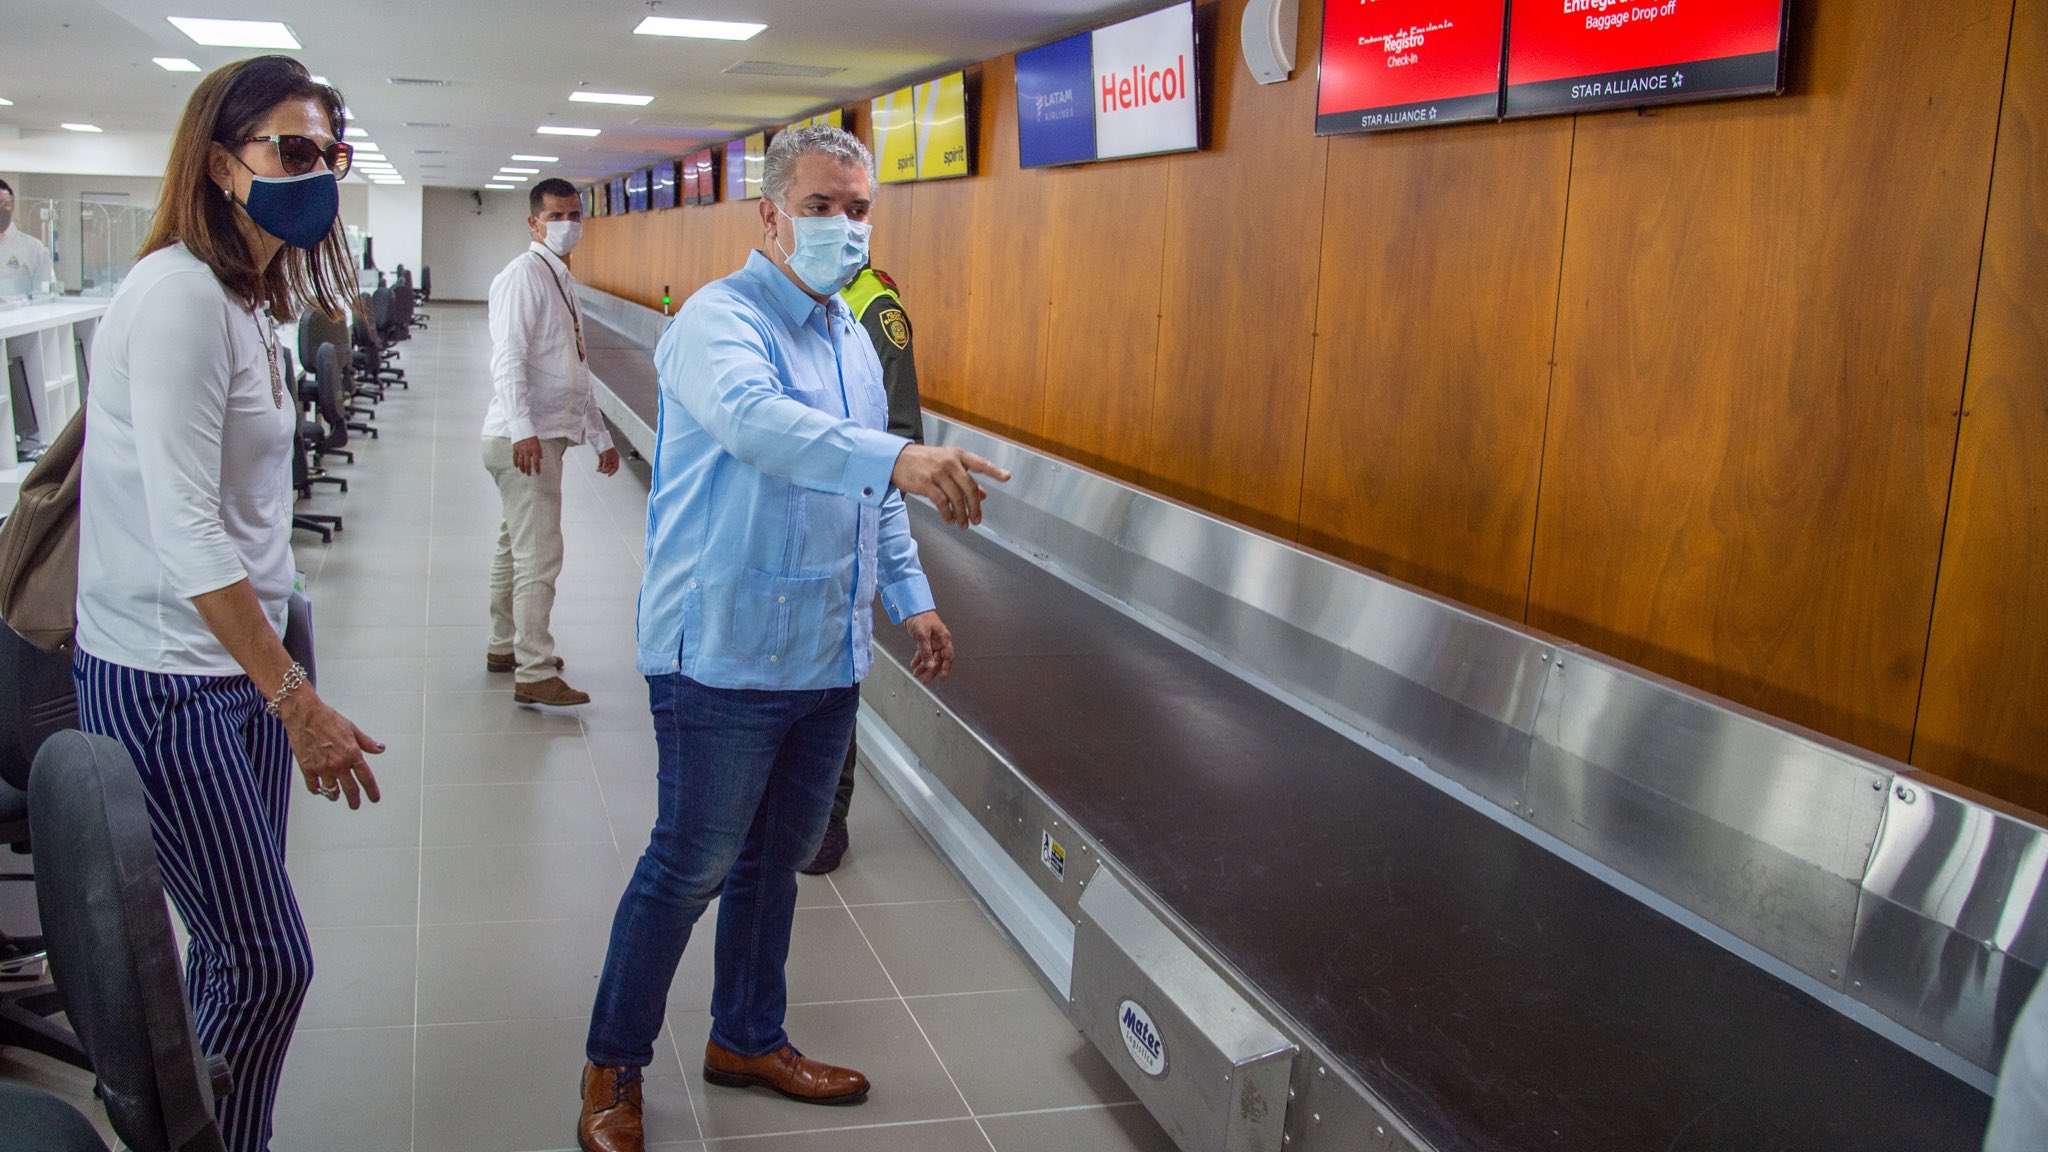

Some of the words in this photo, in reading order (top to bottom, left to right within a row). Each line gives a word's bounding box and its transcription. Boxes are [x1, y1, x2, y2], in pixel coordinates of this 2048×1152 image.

[1585, 11, 1630, 30] Baggage
[1631, 7, 1658, 21] Drop
[1660, 0, 1677, 16] off
[1383, 33, 1424, 54] Registro
[1101, 54, 1185, 113] Helicol
[1571, 80, 1601, 98] STAR
[1604, 74, 1667, 95] ALLIANCE
[1044, 88, 1073, 107] LATAM
[1361, 114, 1383, 127] STAR
[1384, 109, 1426, 125] ALLIANCE
[897, 153, 914, 172] spirit
[944, 145, 964, 167] spirit
[1123, 1007, 1161, 1057] Matec
